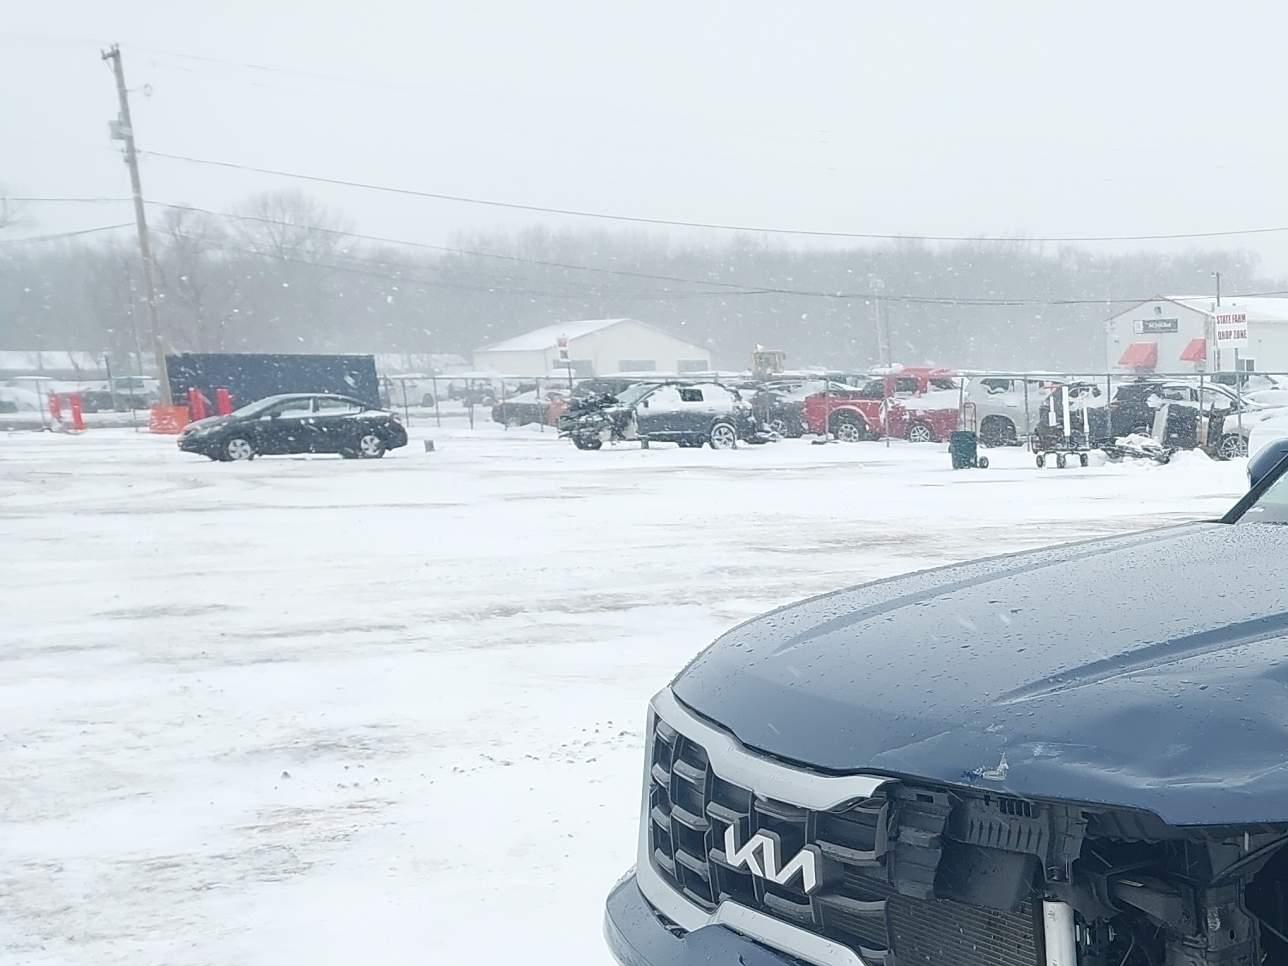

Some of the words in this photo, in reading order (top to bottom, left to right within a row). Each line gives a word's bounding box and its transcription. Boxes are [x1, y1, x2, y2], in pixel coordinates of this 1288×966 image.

[1216, 314, 1231, 324] STATE
[1232, 313, 1246, 323] FARM
[1217, 330, 1232, 340] DROP
[1233, 329, 1247, 339] ZONE
